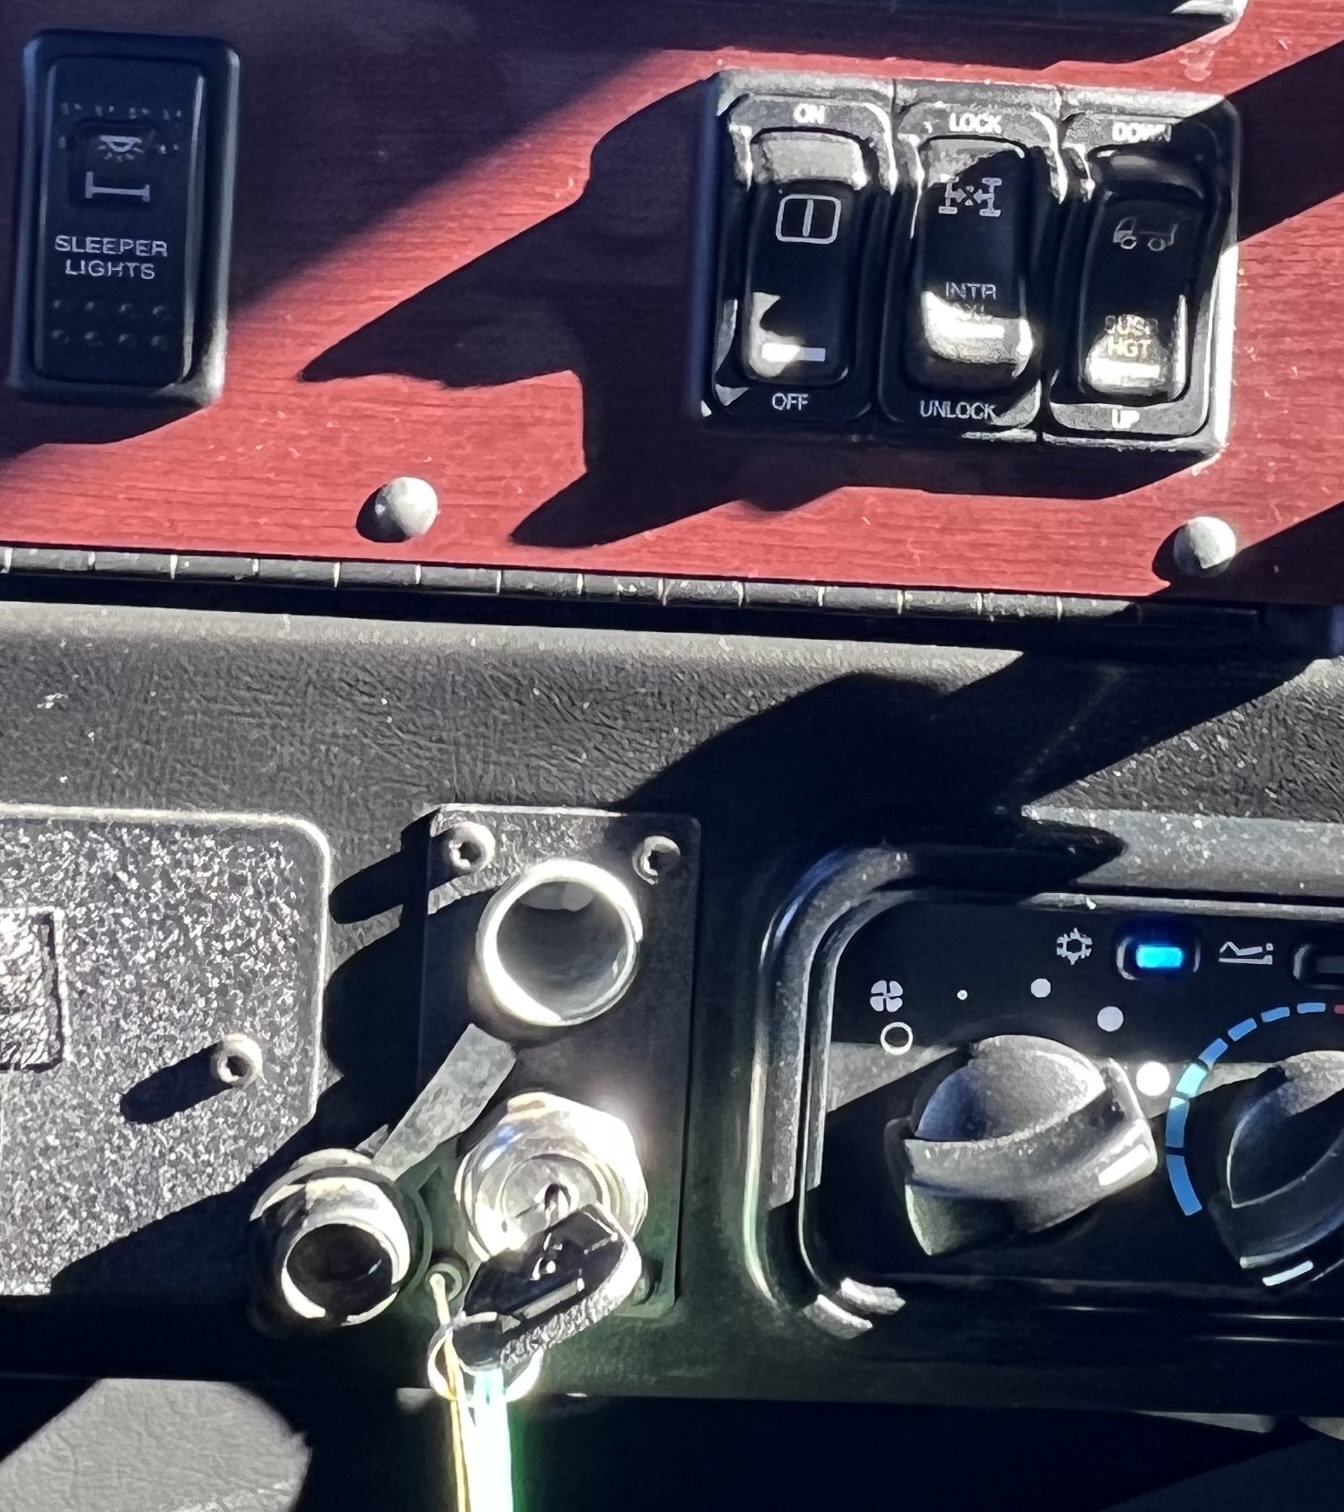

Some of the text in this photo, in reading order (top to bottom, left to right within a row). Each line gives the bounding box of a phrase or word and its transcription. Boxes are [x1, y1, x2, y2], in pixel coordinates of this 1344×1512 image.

[793, 105, 826, 124] ON
[949, 115, 1002, 133] LOCK
[1112, 122, 1172, 143] DOWN
[55, 235, 168, 257] SLEEPER
[65, 259, 156, 279] LIGHTS
[945, 282, 997, 300] INTR
[1107, 336, 1152, 359] HGT
[772, 392, 809, 412] OFF
[920, 400, 995, 420] UNLOCK
[1112, 410, 1141, 429] UP
